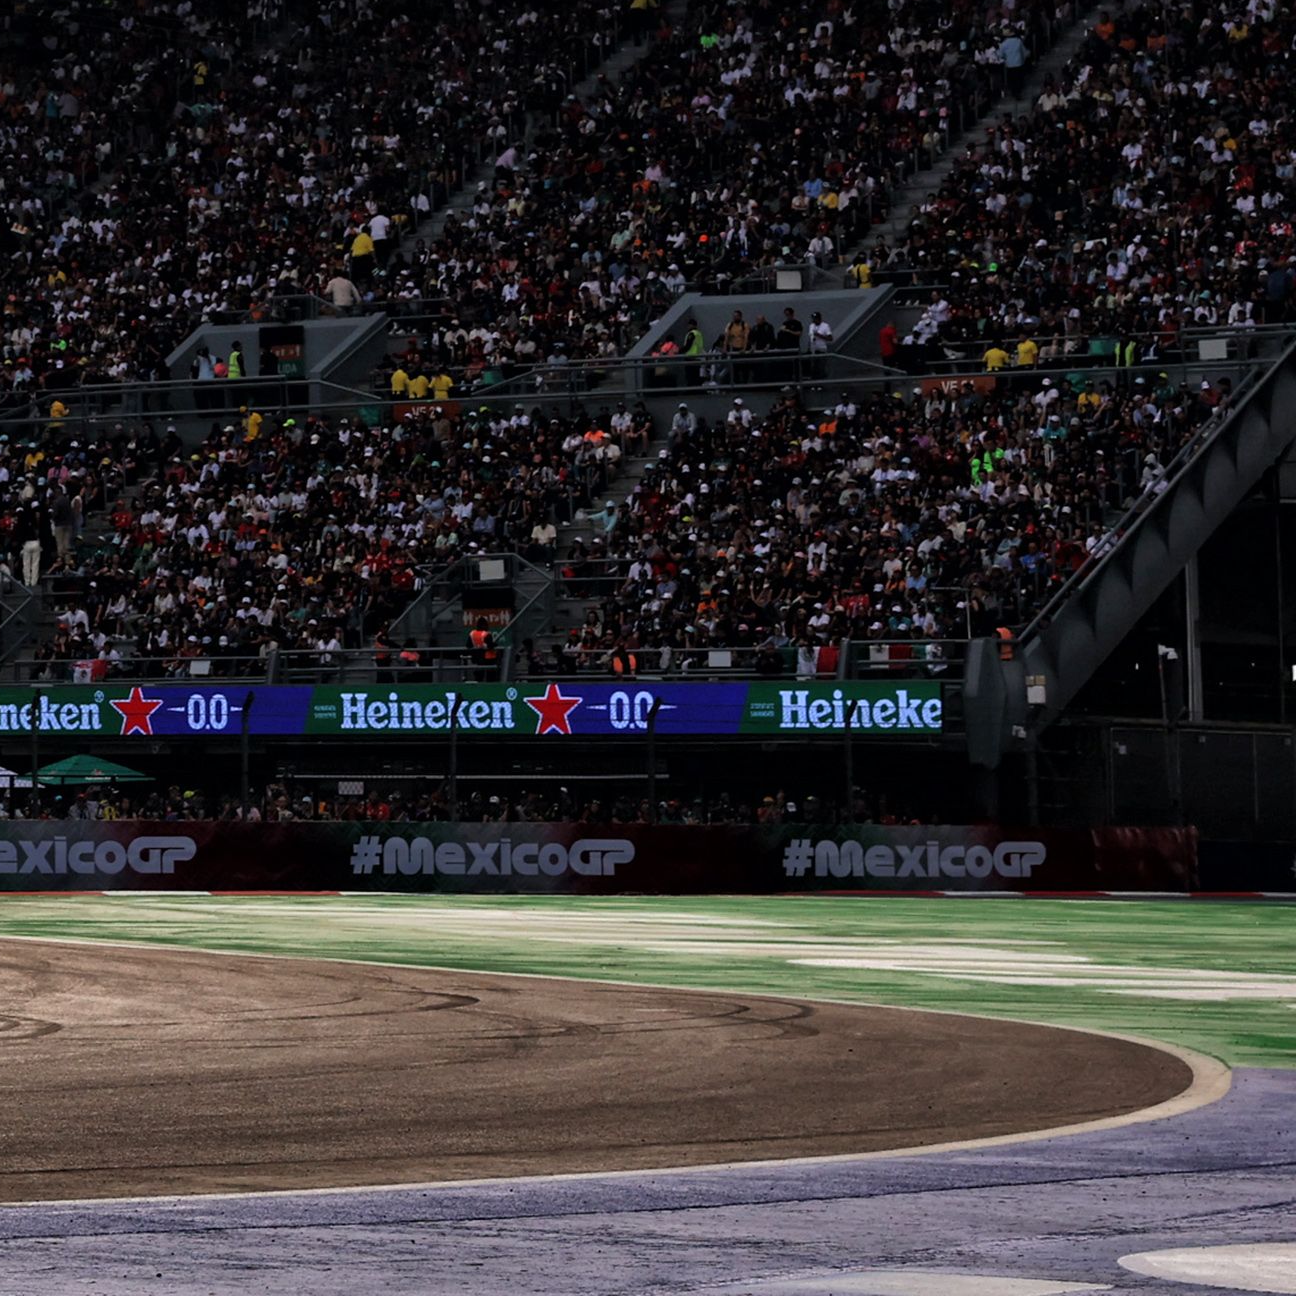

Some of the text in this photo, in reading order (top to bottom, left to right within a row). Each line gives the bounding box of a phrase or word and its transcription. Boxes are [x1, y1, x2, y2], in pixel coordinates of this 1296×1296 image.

[941, 380, 957, 394] VE
[188, 694, 227, 730] 0.0
[610, 691, 654, 729] 0.0
[350, 836, 636, 876] #MexicoGP
[782, 839, 1047, 878] #MexicoGP
